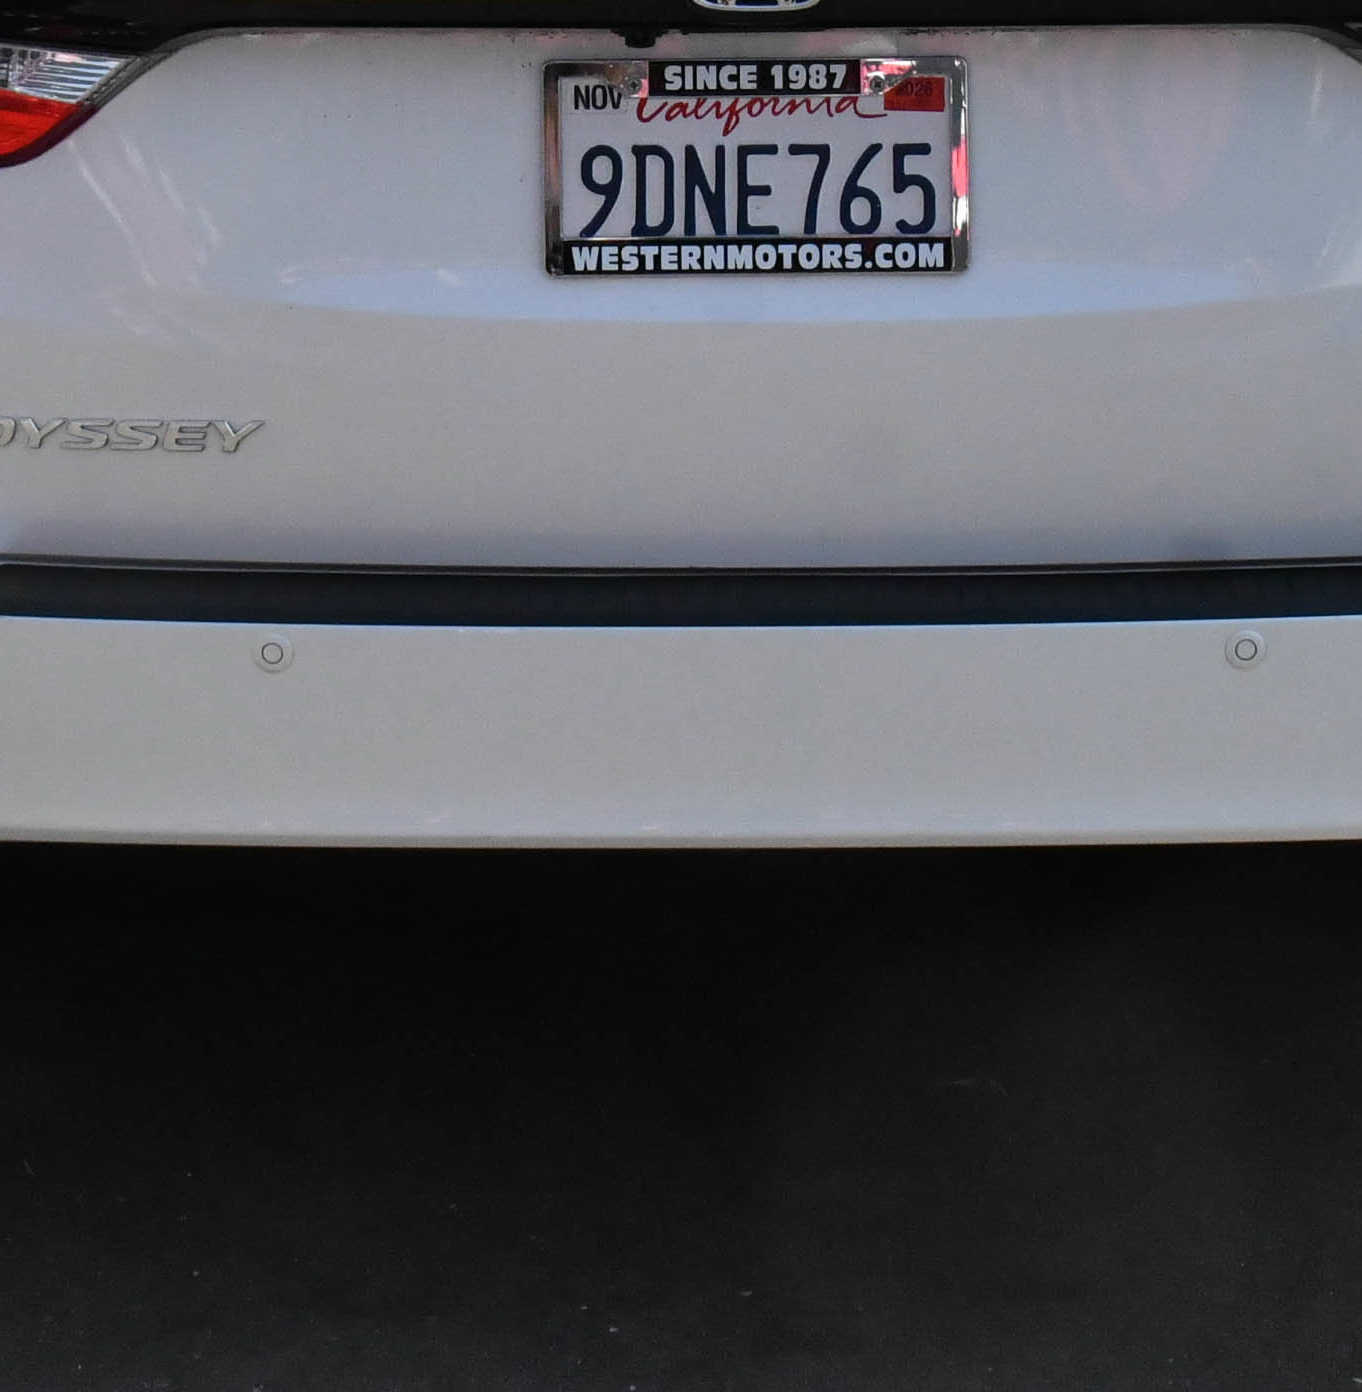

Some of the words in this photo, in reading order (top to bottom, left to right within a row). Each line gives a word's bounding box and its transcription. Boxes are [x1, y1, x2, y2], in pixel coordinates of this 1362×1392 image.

[664, 64, 758, 91] SINCE
[770, 63, 847, 90] 1987
[574, 83, 623, 110] NOV
[579, 142, 937, 238] 9DNE765
[571, 243, 945, 272] WESTERNMOTORS.COM
